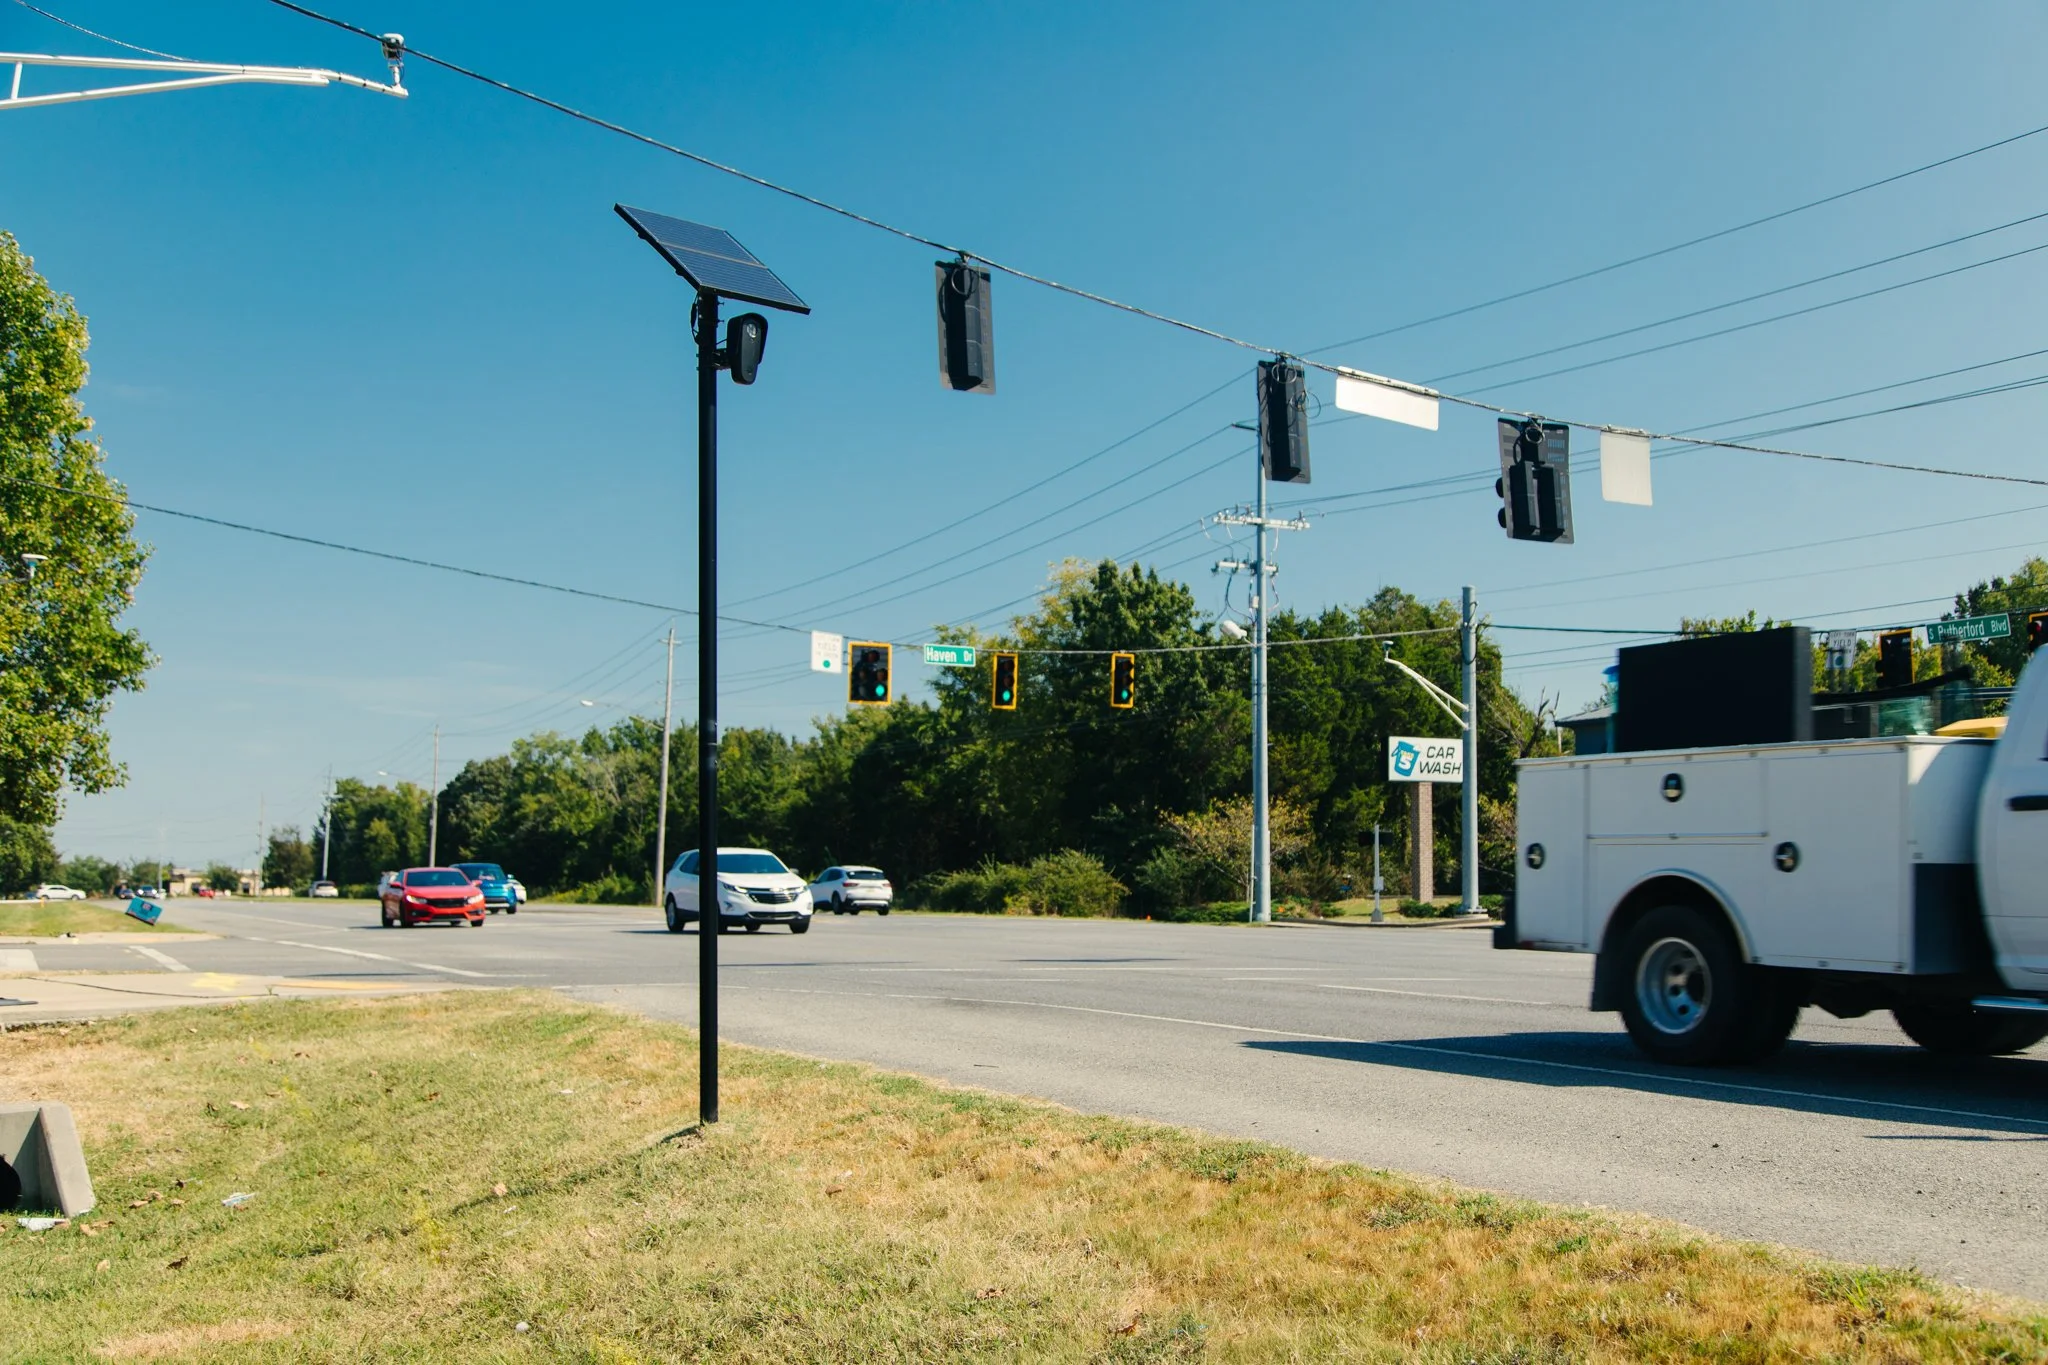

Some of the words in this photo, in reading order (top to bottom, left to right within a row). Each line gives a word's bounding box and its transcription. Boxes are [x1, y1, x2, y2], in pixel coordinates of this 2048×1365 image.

[1928, 628, 1935, 640] S
[1990, 619, 2007, 633] Blvd
[926, 646, 957, 662] Haven
[963, 650, 973, 662] Dr
[1426, 746, 1455, 759] CAR
[1420, 761, 1462, 775] WASH
